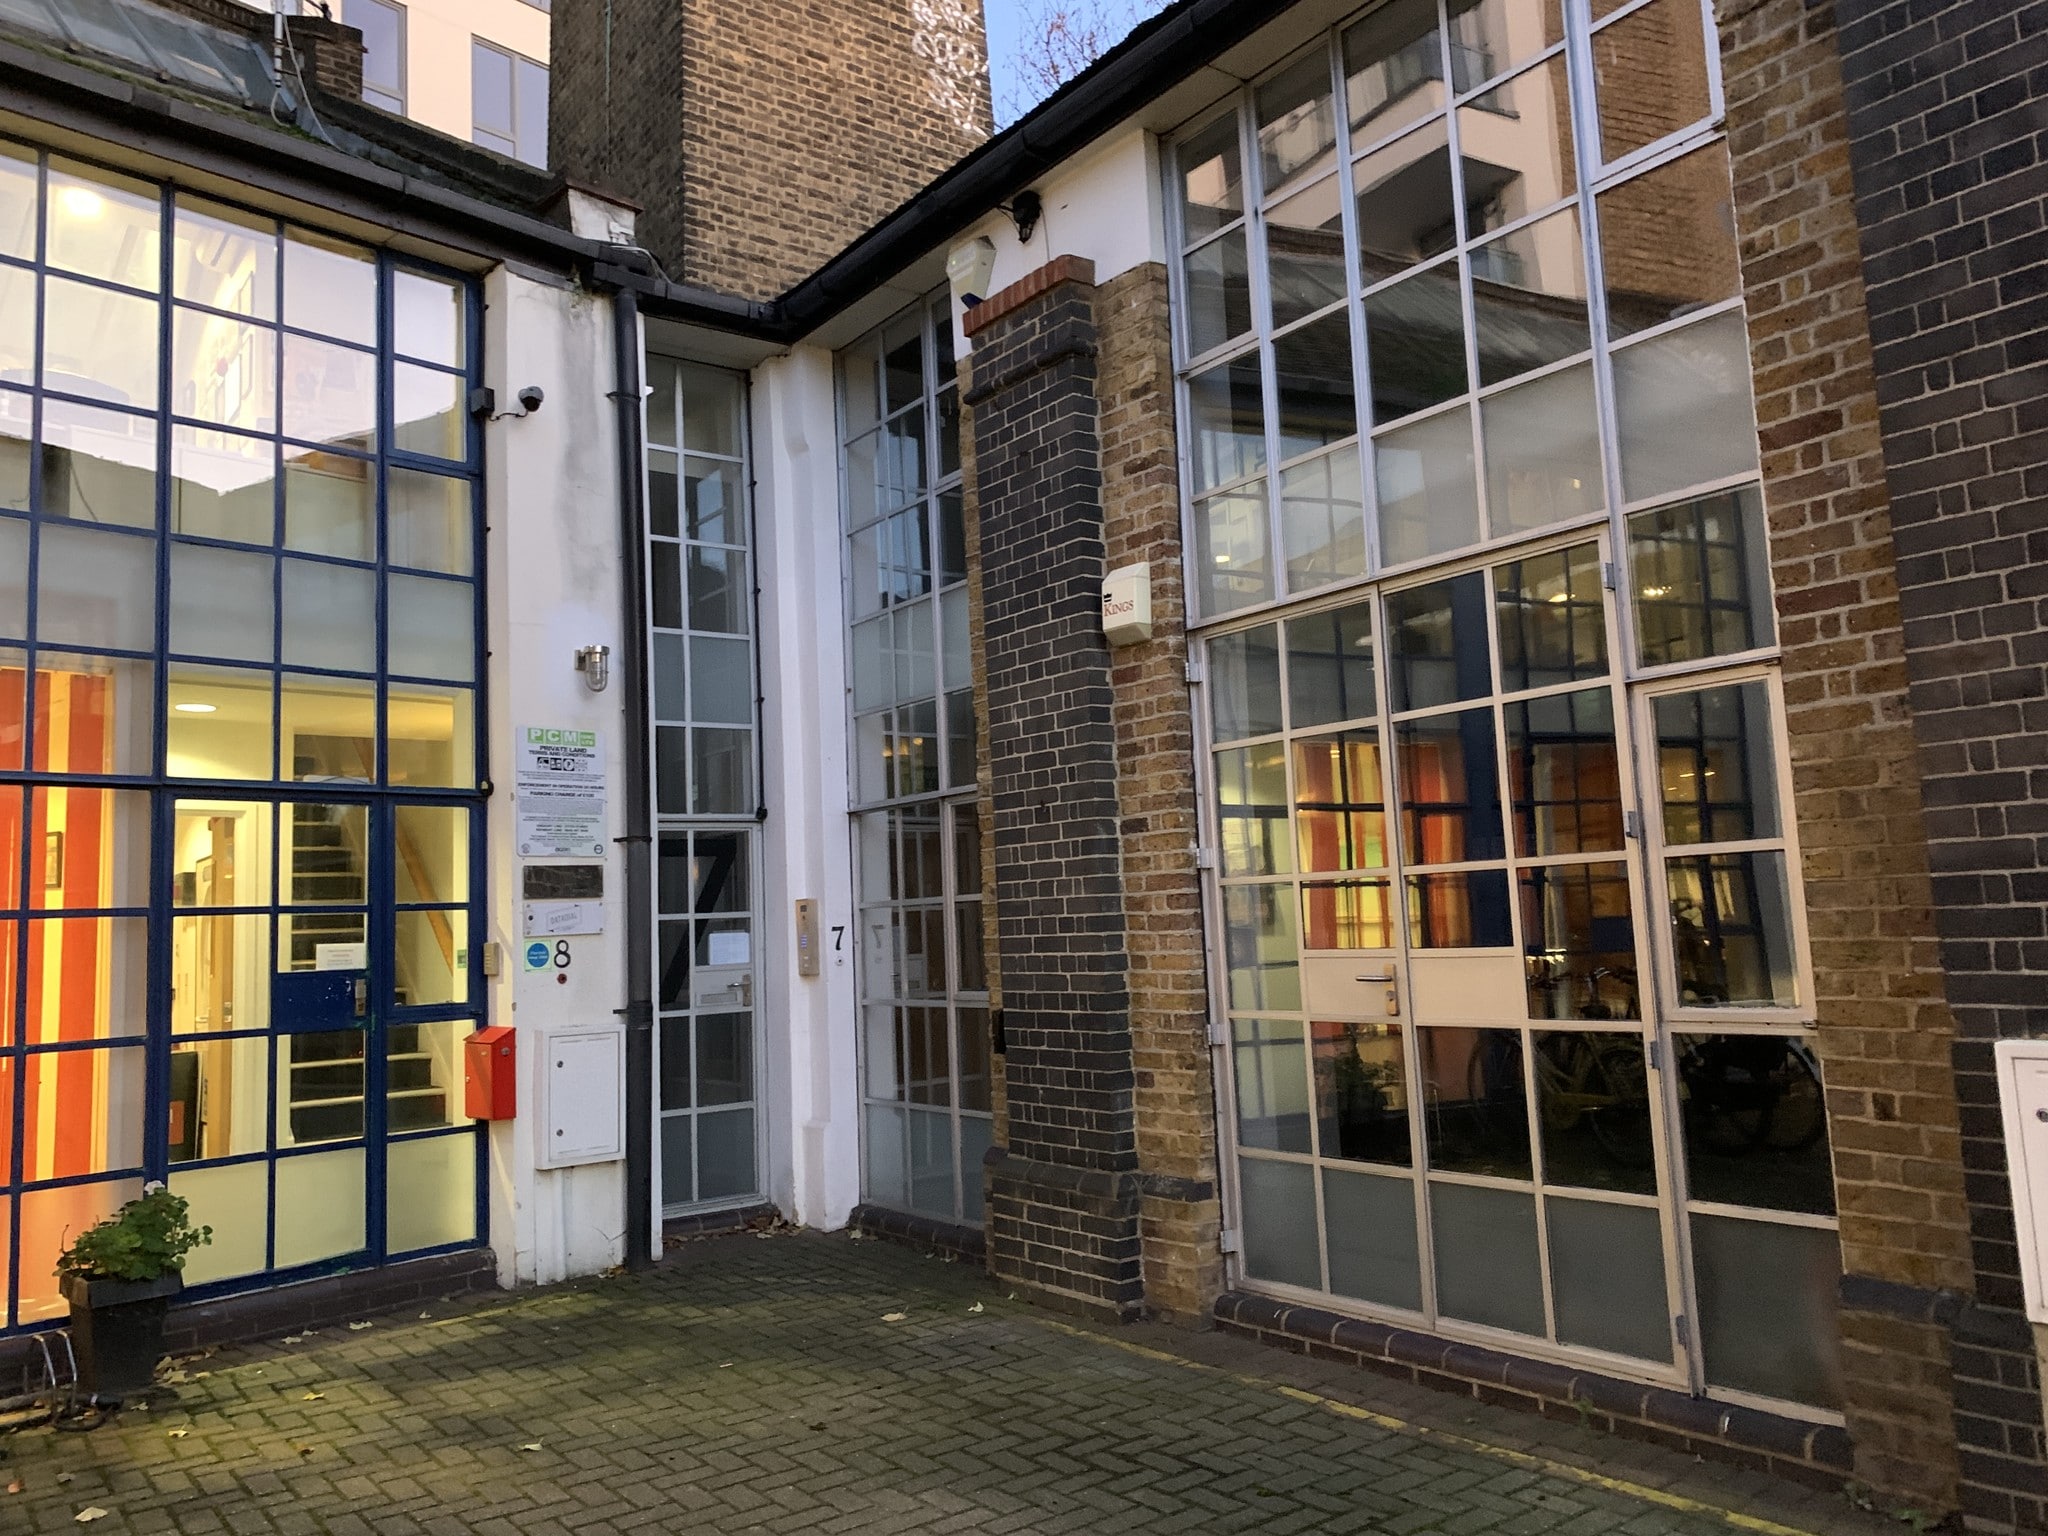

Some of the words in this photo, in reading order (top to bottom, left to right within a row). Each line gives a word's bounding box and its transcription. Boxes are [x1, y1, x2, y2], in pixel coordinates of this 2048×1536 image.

[530, 729, 578, 743] PCM
[831, 926, 845, 950] 7
[554, 940, 571, 968] 8
